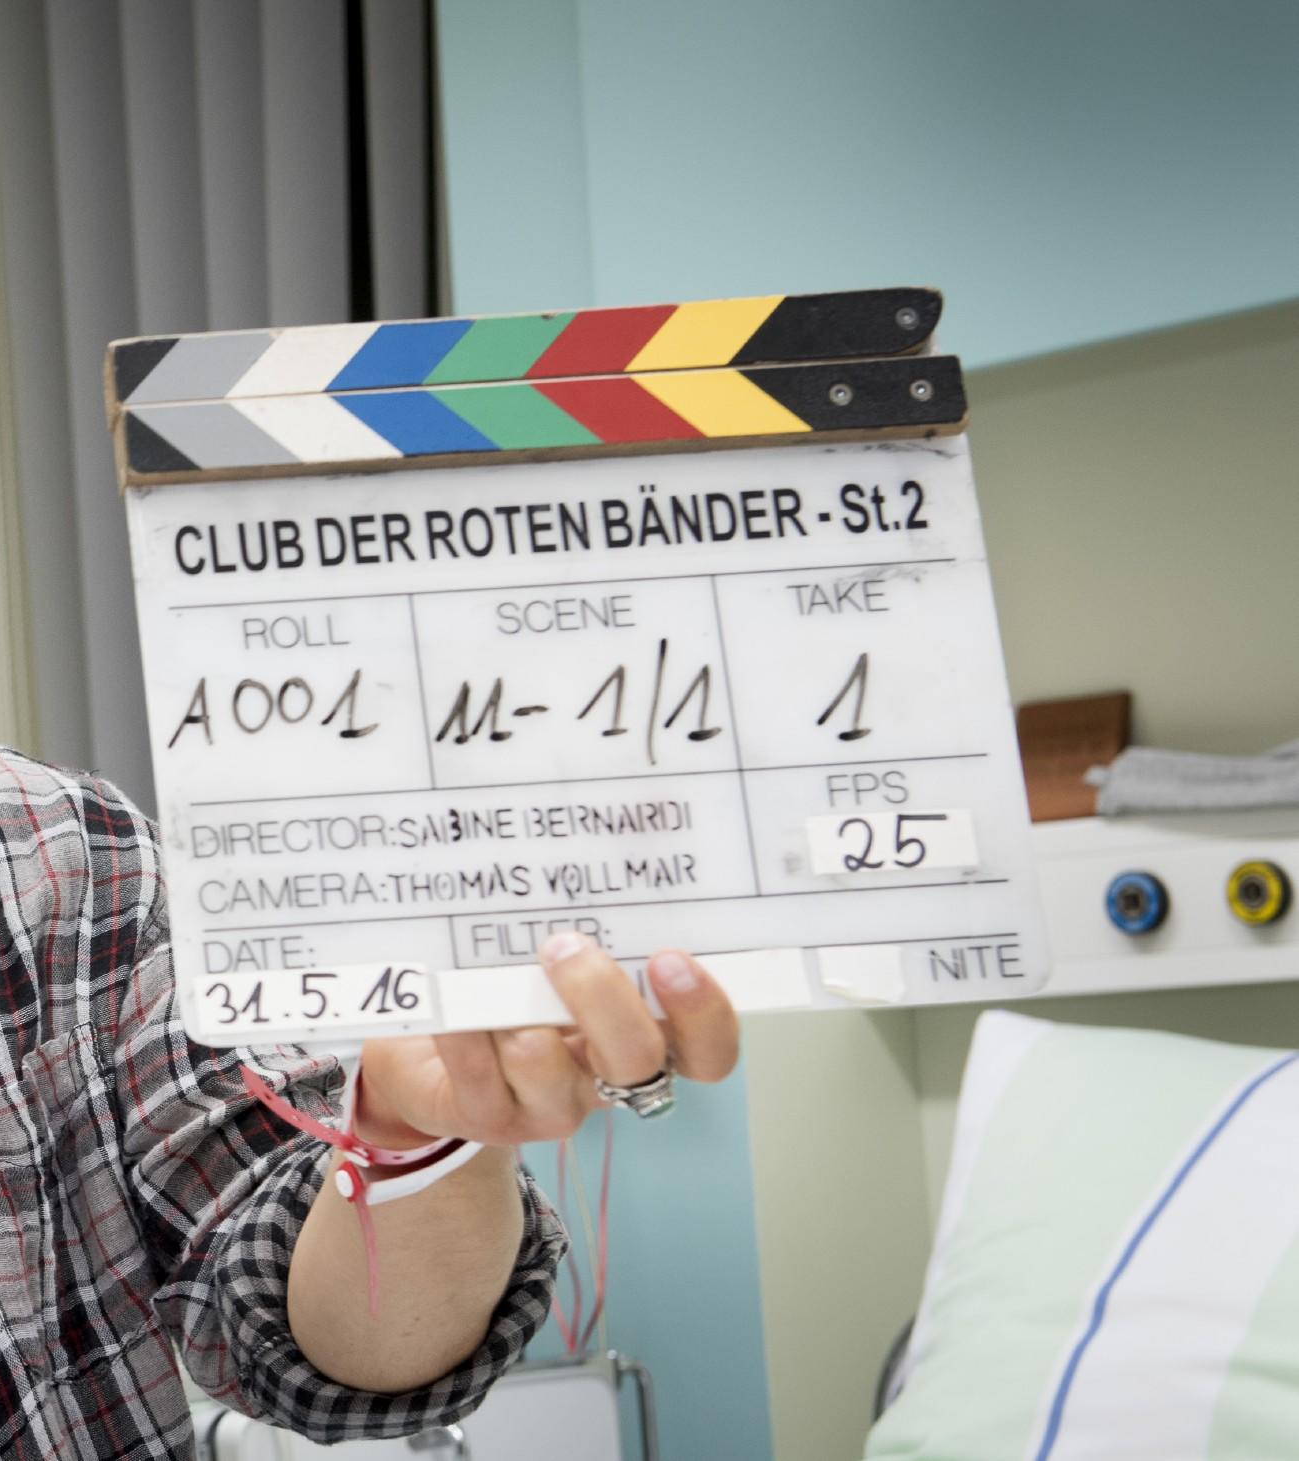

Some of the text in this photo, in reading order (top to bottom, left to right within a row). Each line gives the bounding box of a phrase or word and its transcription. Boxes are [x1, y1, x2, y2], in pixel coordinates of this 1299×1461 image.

[175, 520, 304, 576] CLUB
[315, 512, 416, 567] DER
[425, 501, 592, 560] ROTEN
[601, 484, 809, 549] BÄNDER
[840, 480, 929, 535] St.2
[496, 594, 636, 635] SCENE
[785, 579, 891, 616] TAKE
[242, 614, 351, 651] ROLL
[816, 652, 873, 742] 1
[826, 769, 911, 808] FPS
[522, 800, 694, 840] BERNARDI
[838, 812, 948, 873] 25
[541, 853, 698, 900] VOLLMAR
[202, 935, 317, 975] DATE:
[928, 943, 1026, 983] NITE
